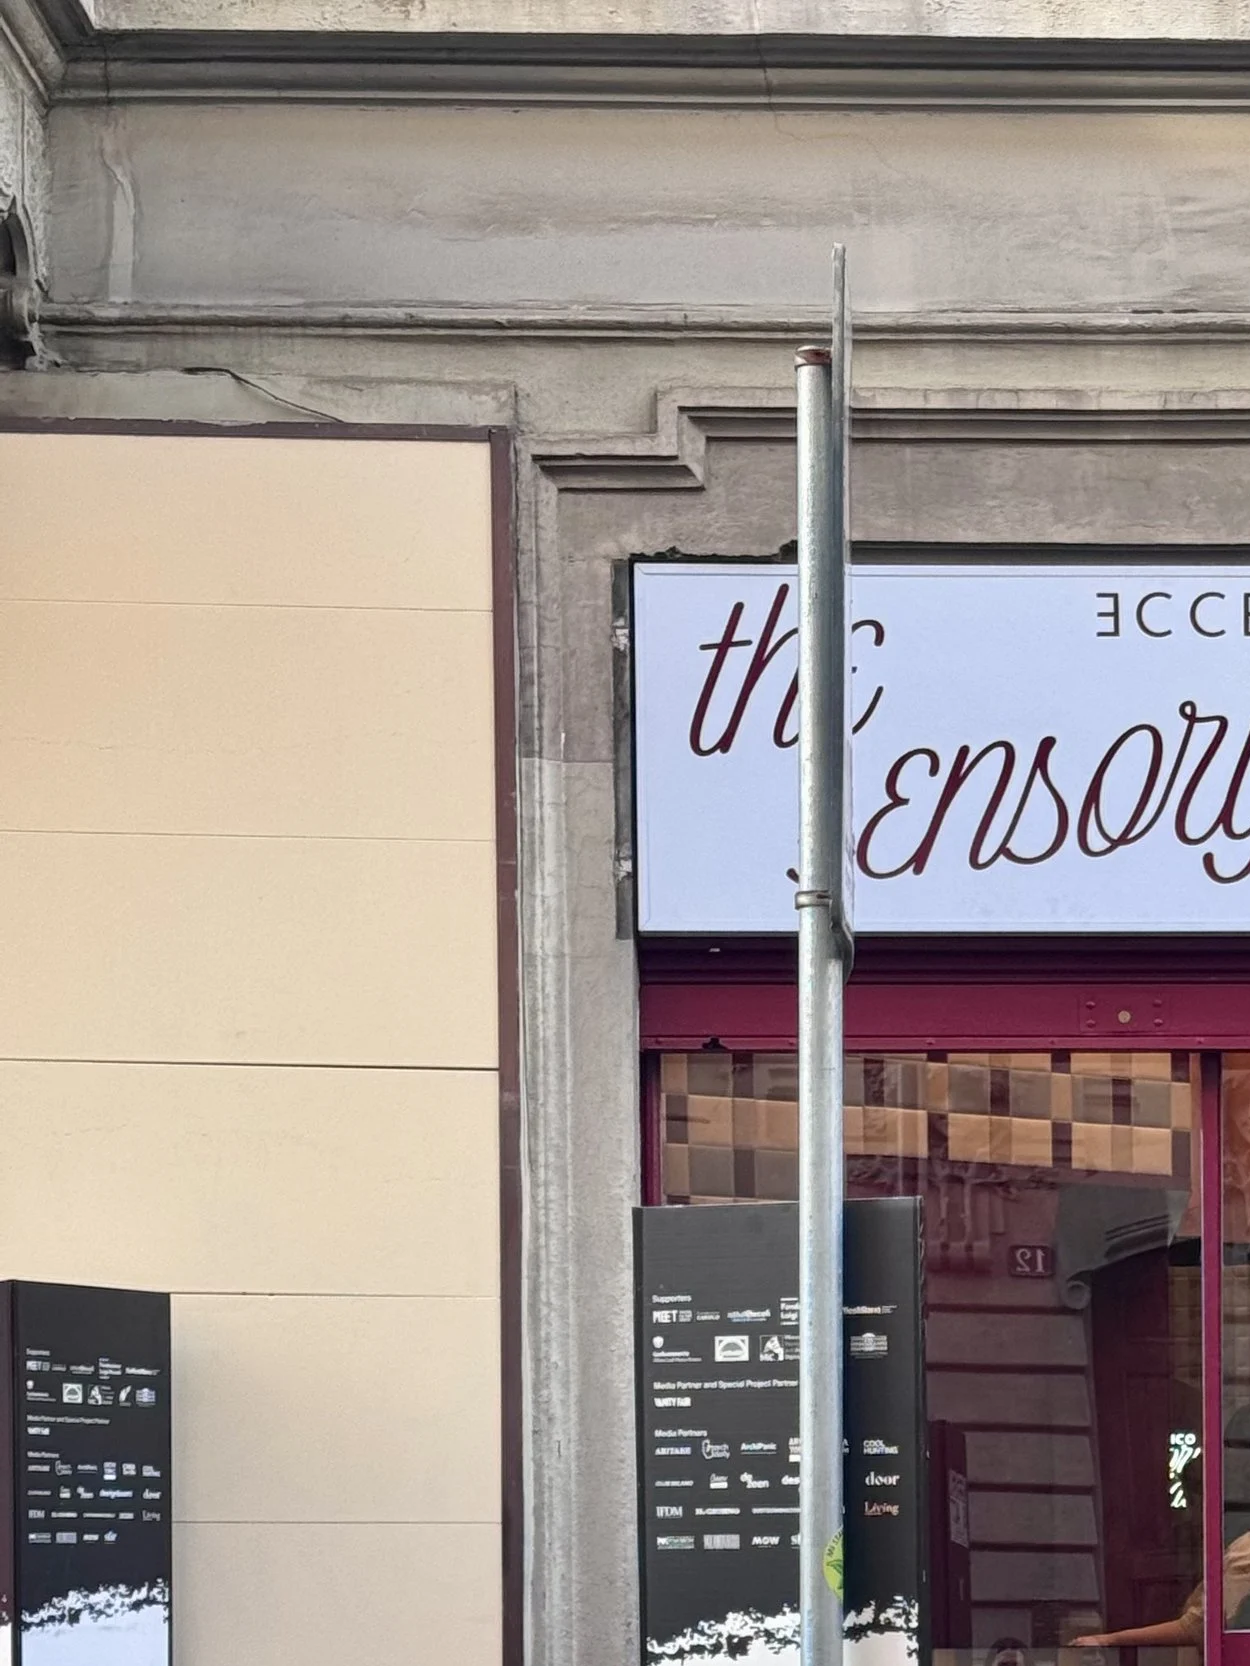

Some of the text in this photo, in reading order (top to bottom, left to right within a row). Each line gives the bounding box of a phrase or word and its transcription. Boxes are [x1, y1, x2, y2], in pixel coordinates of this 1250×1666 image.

[652, 1294, 692, 1304] Supporters
[653, 1379, 798, 1390] Media Partner and Special Project Partner
[654, 1428, 708, 1437] Media Partners
[864, 1471, 900, 1486] door
[864, 1501, 900, 1516] Living
